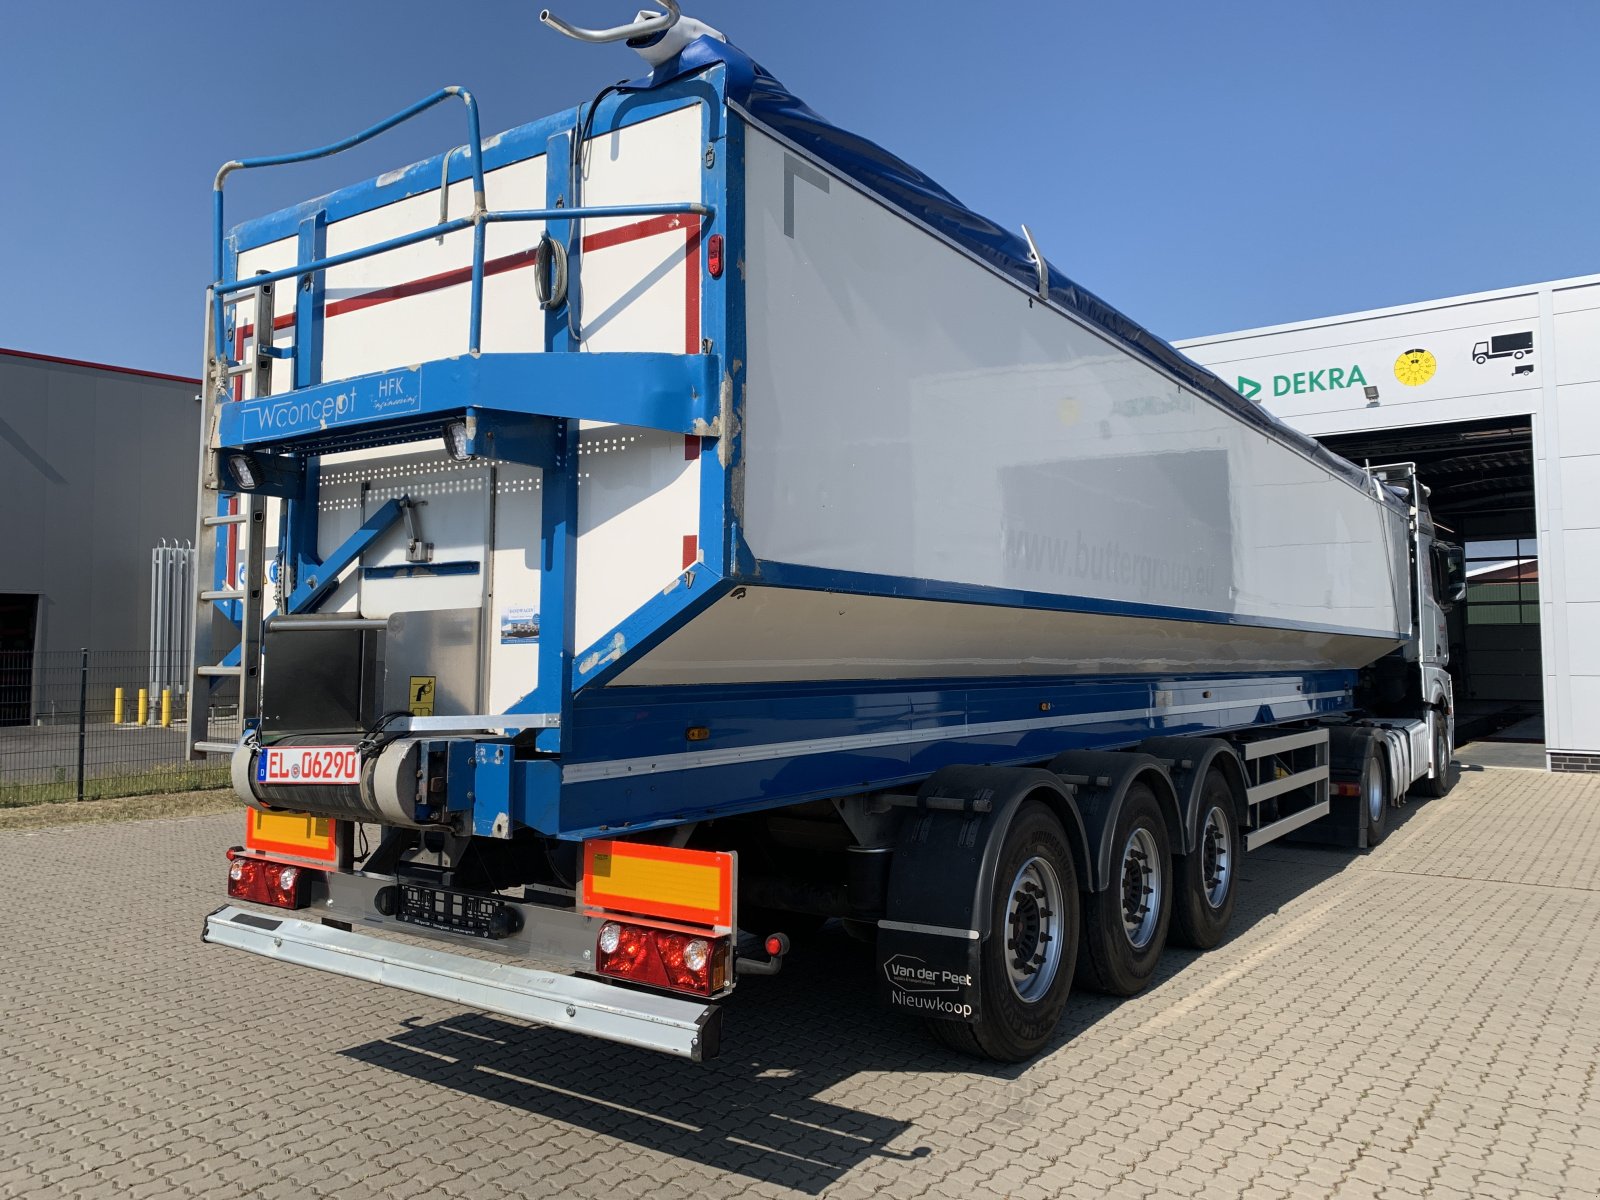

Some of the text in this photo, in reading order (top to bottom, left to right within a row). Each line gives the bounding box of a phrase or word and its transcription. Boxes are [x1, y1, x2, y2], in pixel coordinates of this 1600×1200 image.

[379, 377, 404, 398] HFK
[1273, 364, 1368, 397] DEKRA
[260, 768, 265, 777] D
[269, 751, 356, 779] EL 06290
[891, 963, 972, 986] Van der Peet
[892, 990, 972, 1018] Nieuwkoop
